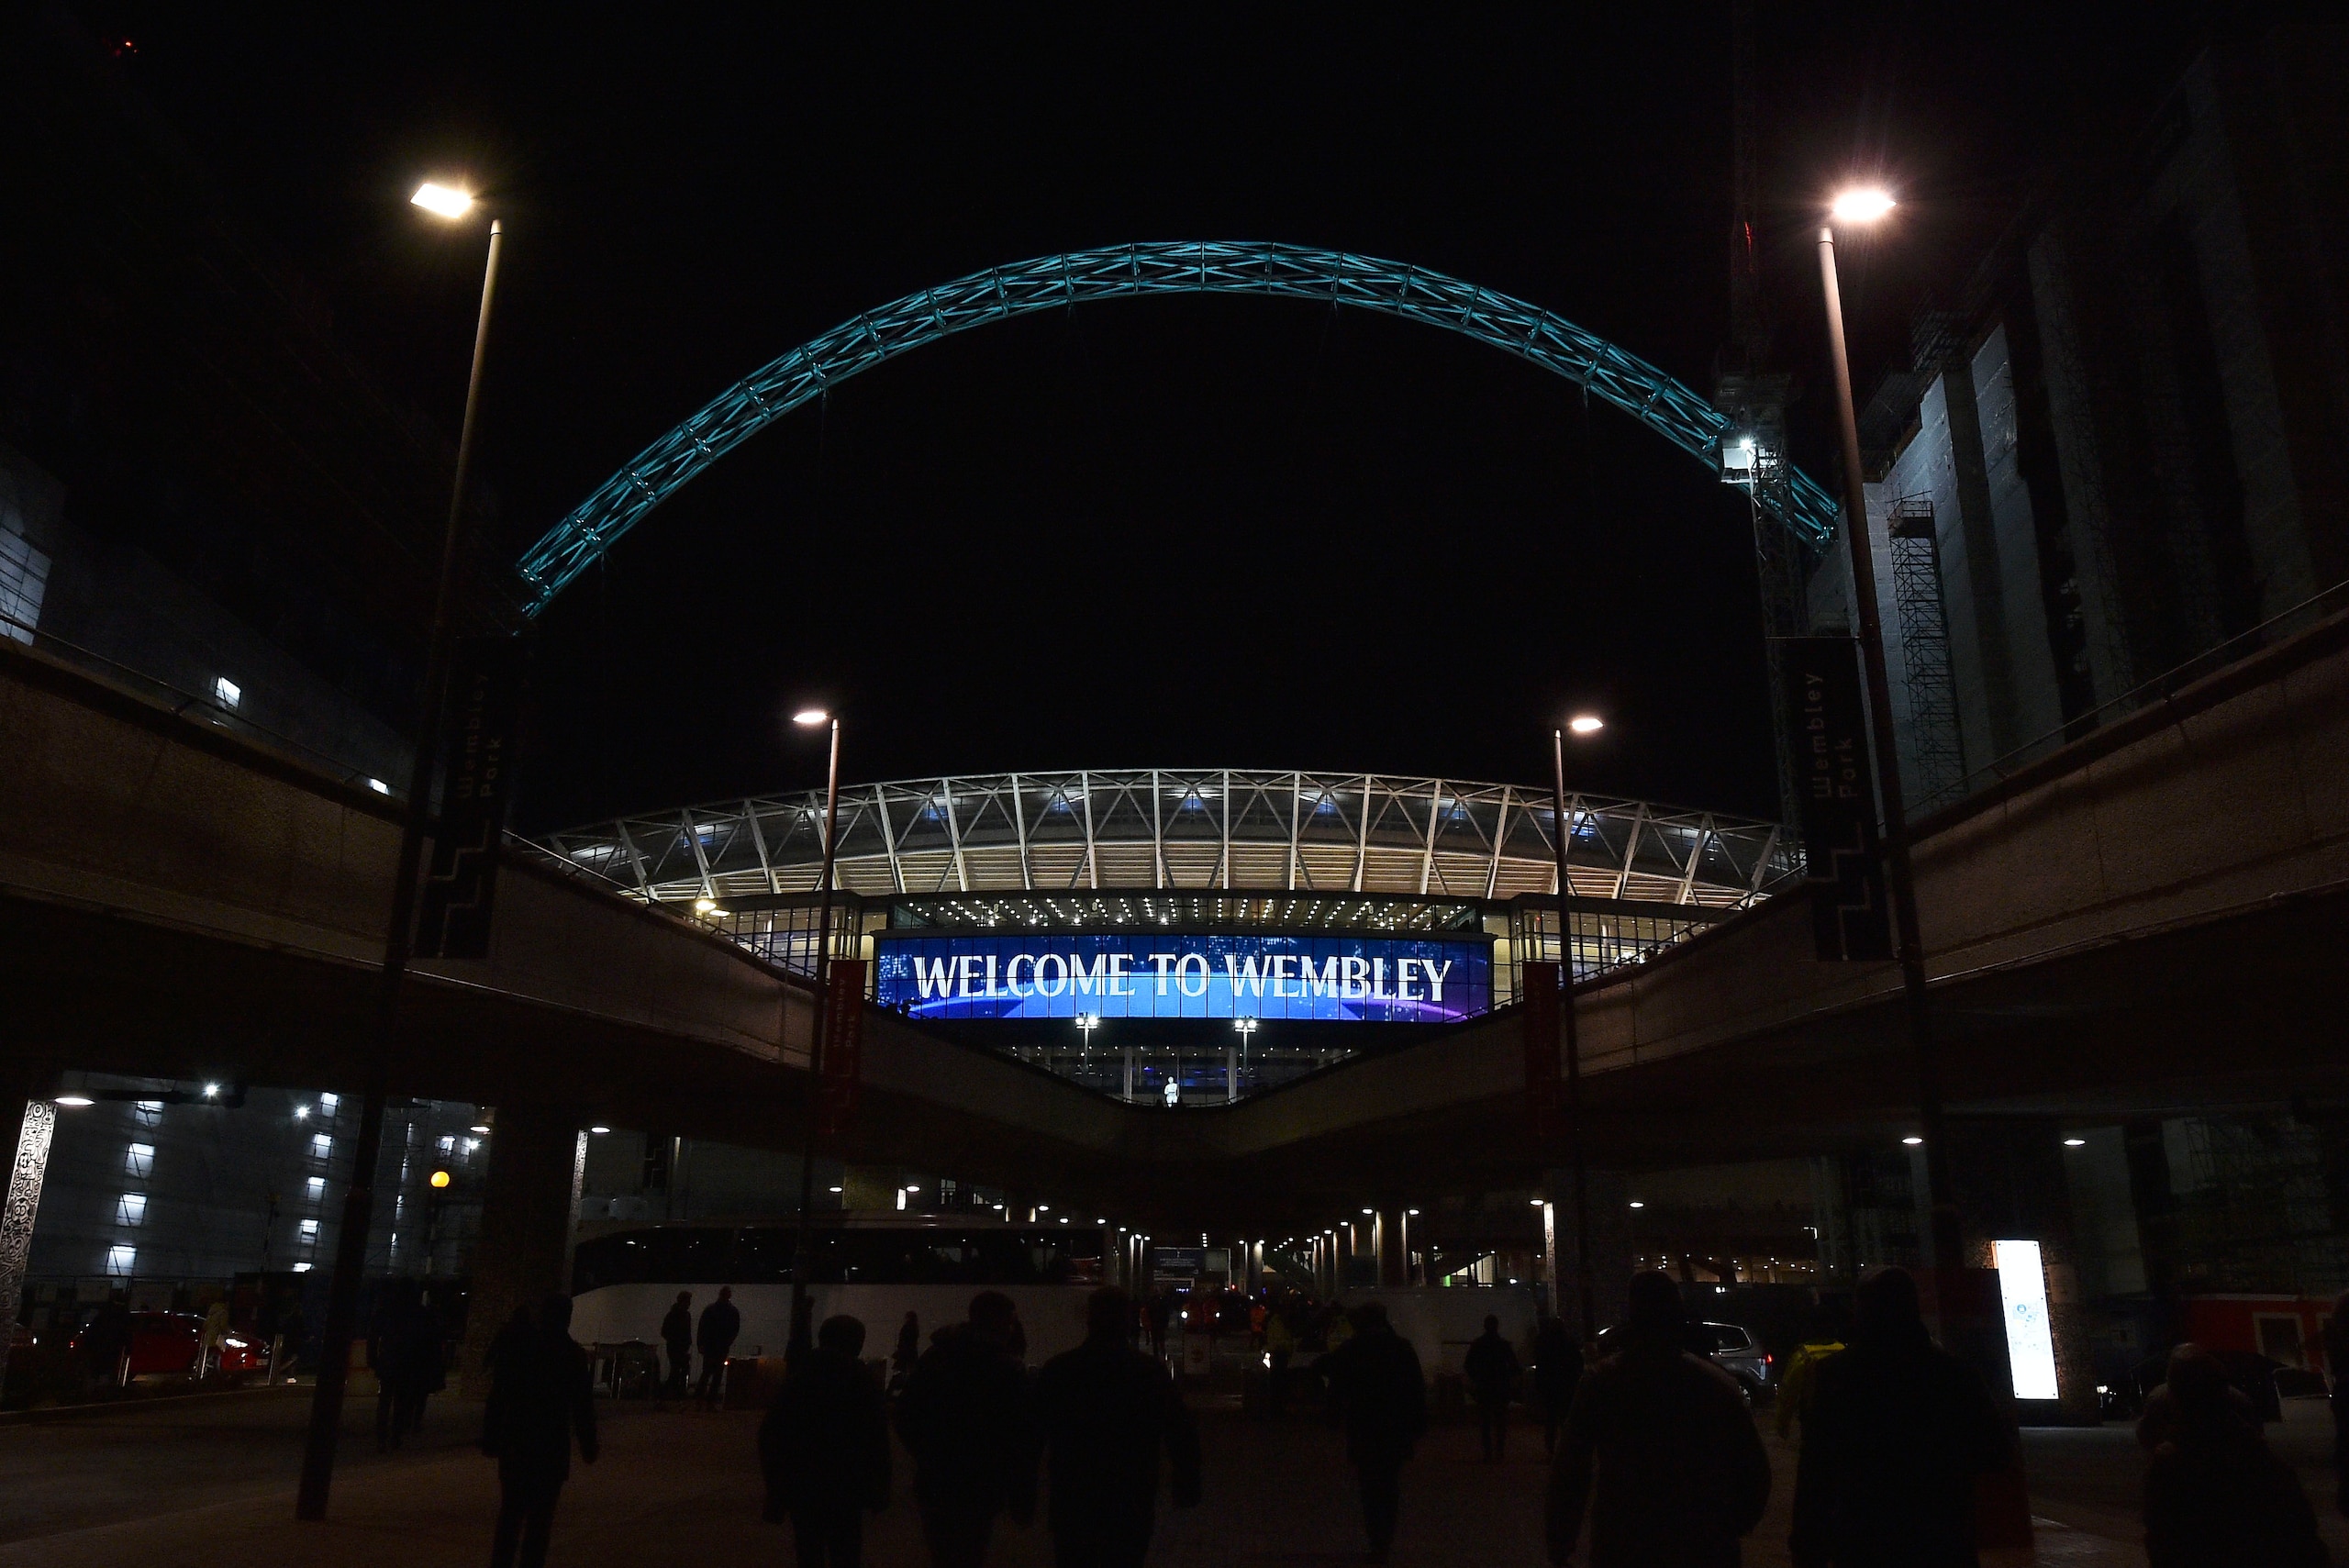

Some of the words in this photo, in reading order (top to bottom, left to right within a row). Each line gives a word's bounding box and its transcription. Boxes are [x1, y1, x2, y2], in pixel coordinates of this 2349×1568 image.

[460, 673, 489, 799] Wembley
[1804, 672, 1833, 799] Wembley
[480, 736, 502, 798] Park
[1837, 737, 1859, 798] Park
[914, 954, 1135, 998] WELCOME
[1149, 953, 1211, 997] TO
[1226, 954, 1453, 1001] WEMBLEY
